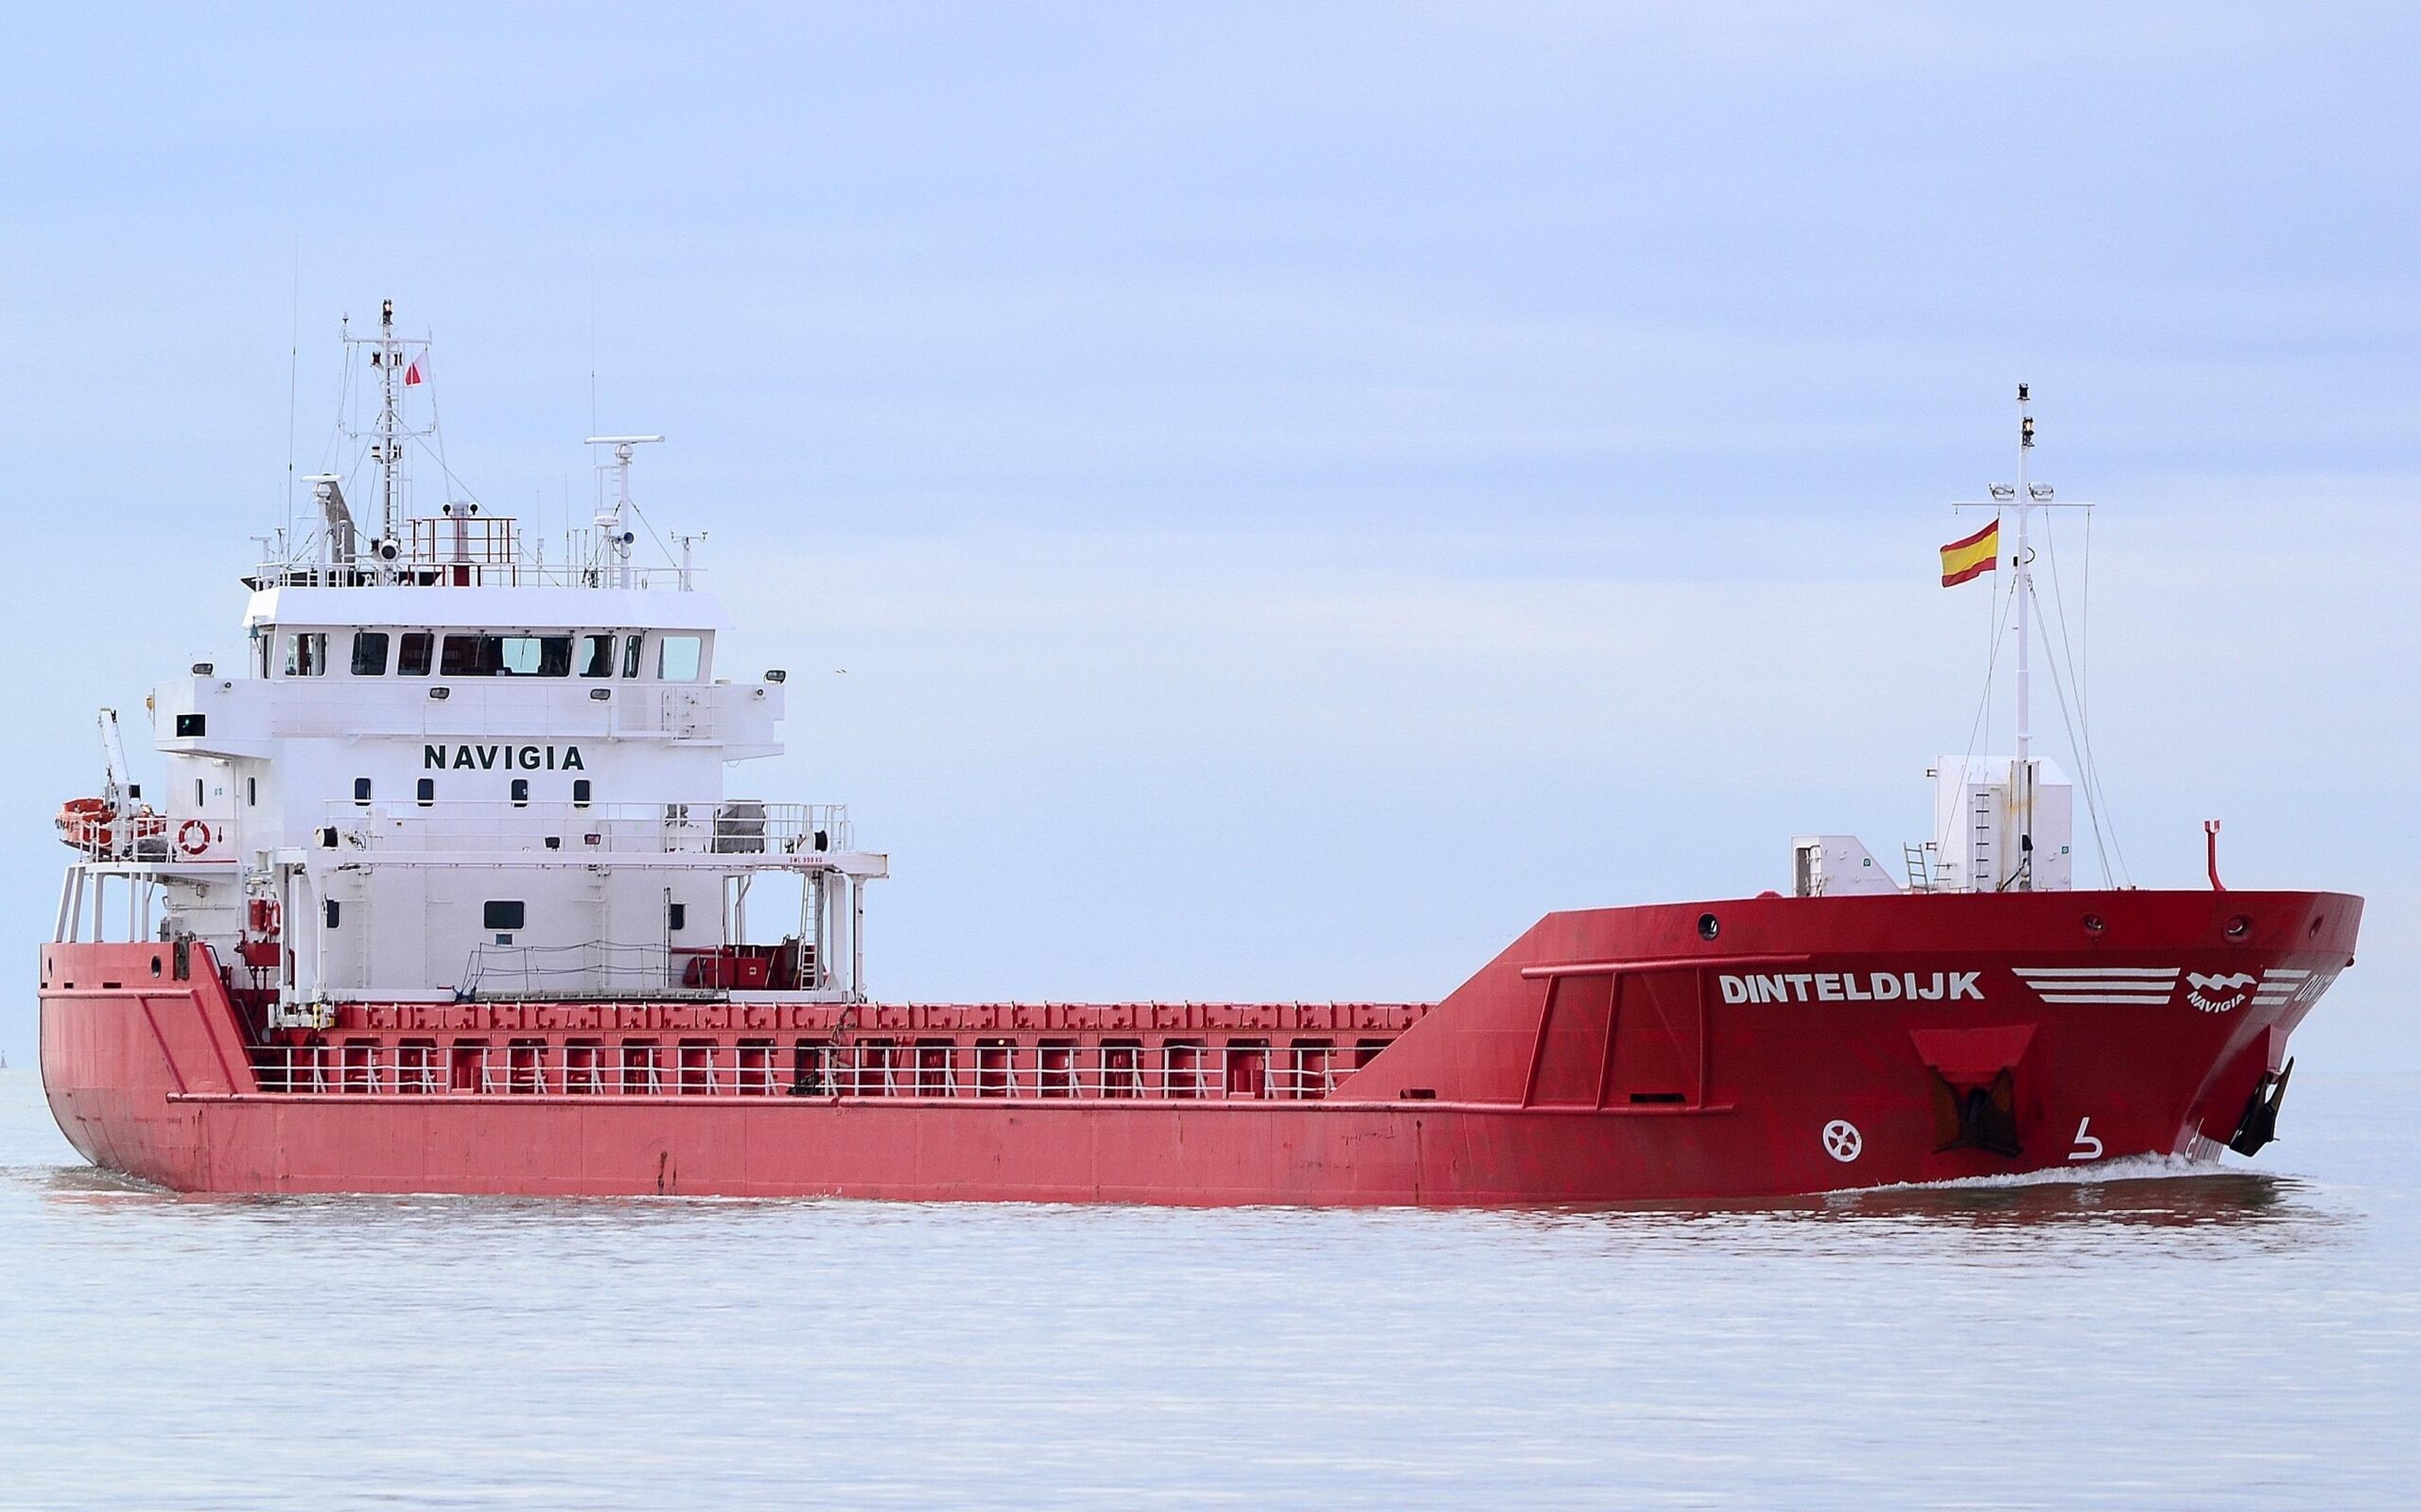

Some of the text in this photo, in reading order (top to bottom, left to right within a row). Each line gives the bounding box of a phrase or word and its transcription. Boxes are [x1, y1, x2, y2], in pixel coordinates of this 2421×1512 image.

[425, 744, 584, 771] NAVIGIA
[1718, 971, 1985, 1004] DINTELDIJK
[2186, 990, 2246, 1014] NAVIGIA
